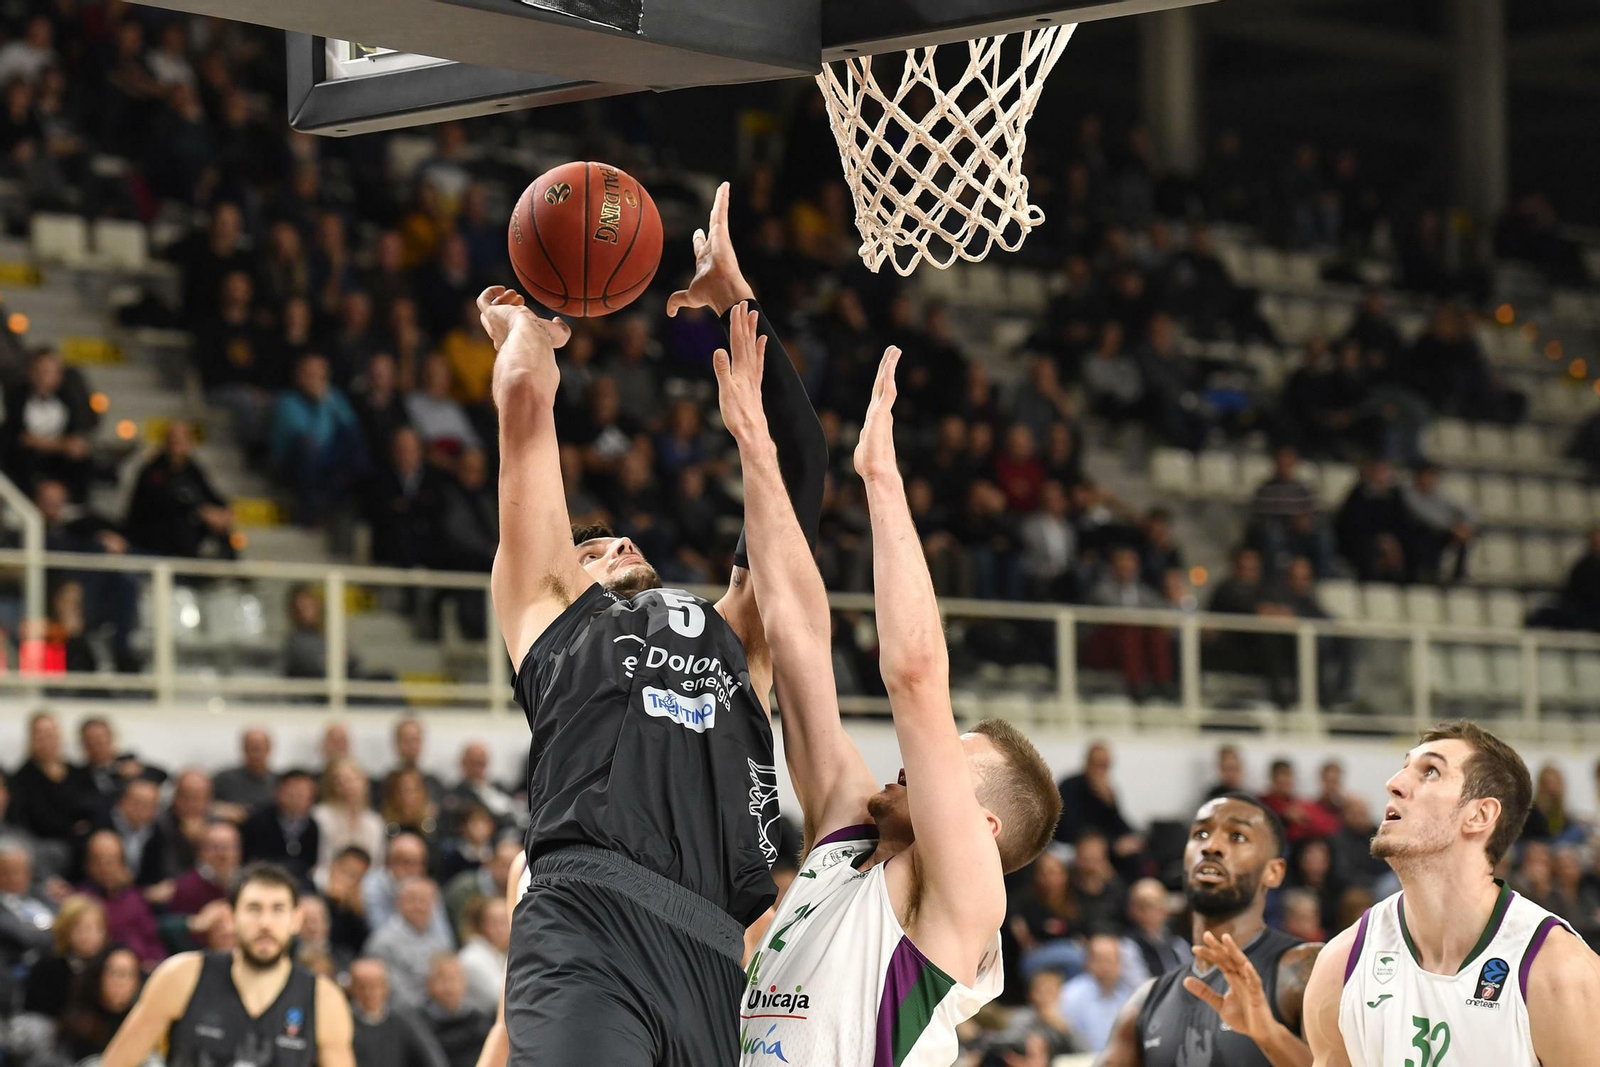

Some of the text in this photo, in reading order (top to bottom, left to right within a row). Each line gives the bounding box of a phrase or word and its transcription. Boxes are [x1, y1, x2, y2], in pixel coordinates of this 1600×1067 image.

[595, 163, 621, 245] PALDING
[660, 592, 706, 638] 5
[681, 676, 731, 712] energia
[747, 985, 810, 1013] Unicaja
[1404, 1015, 1451, 1067] 32
